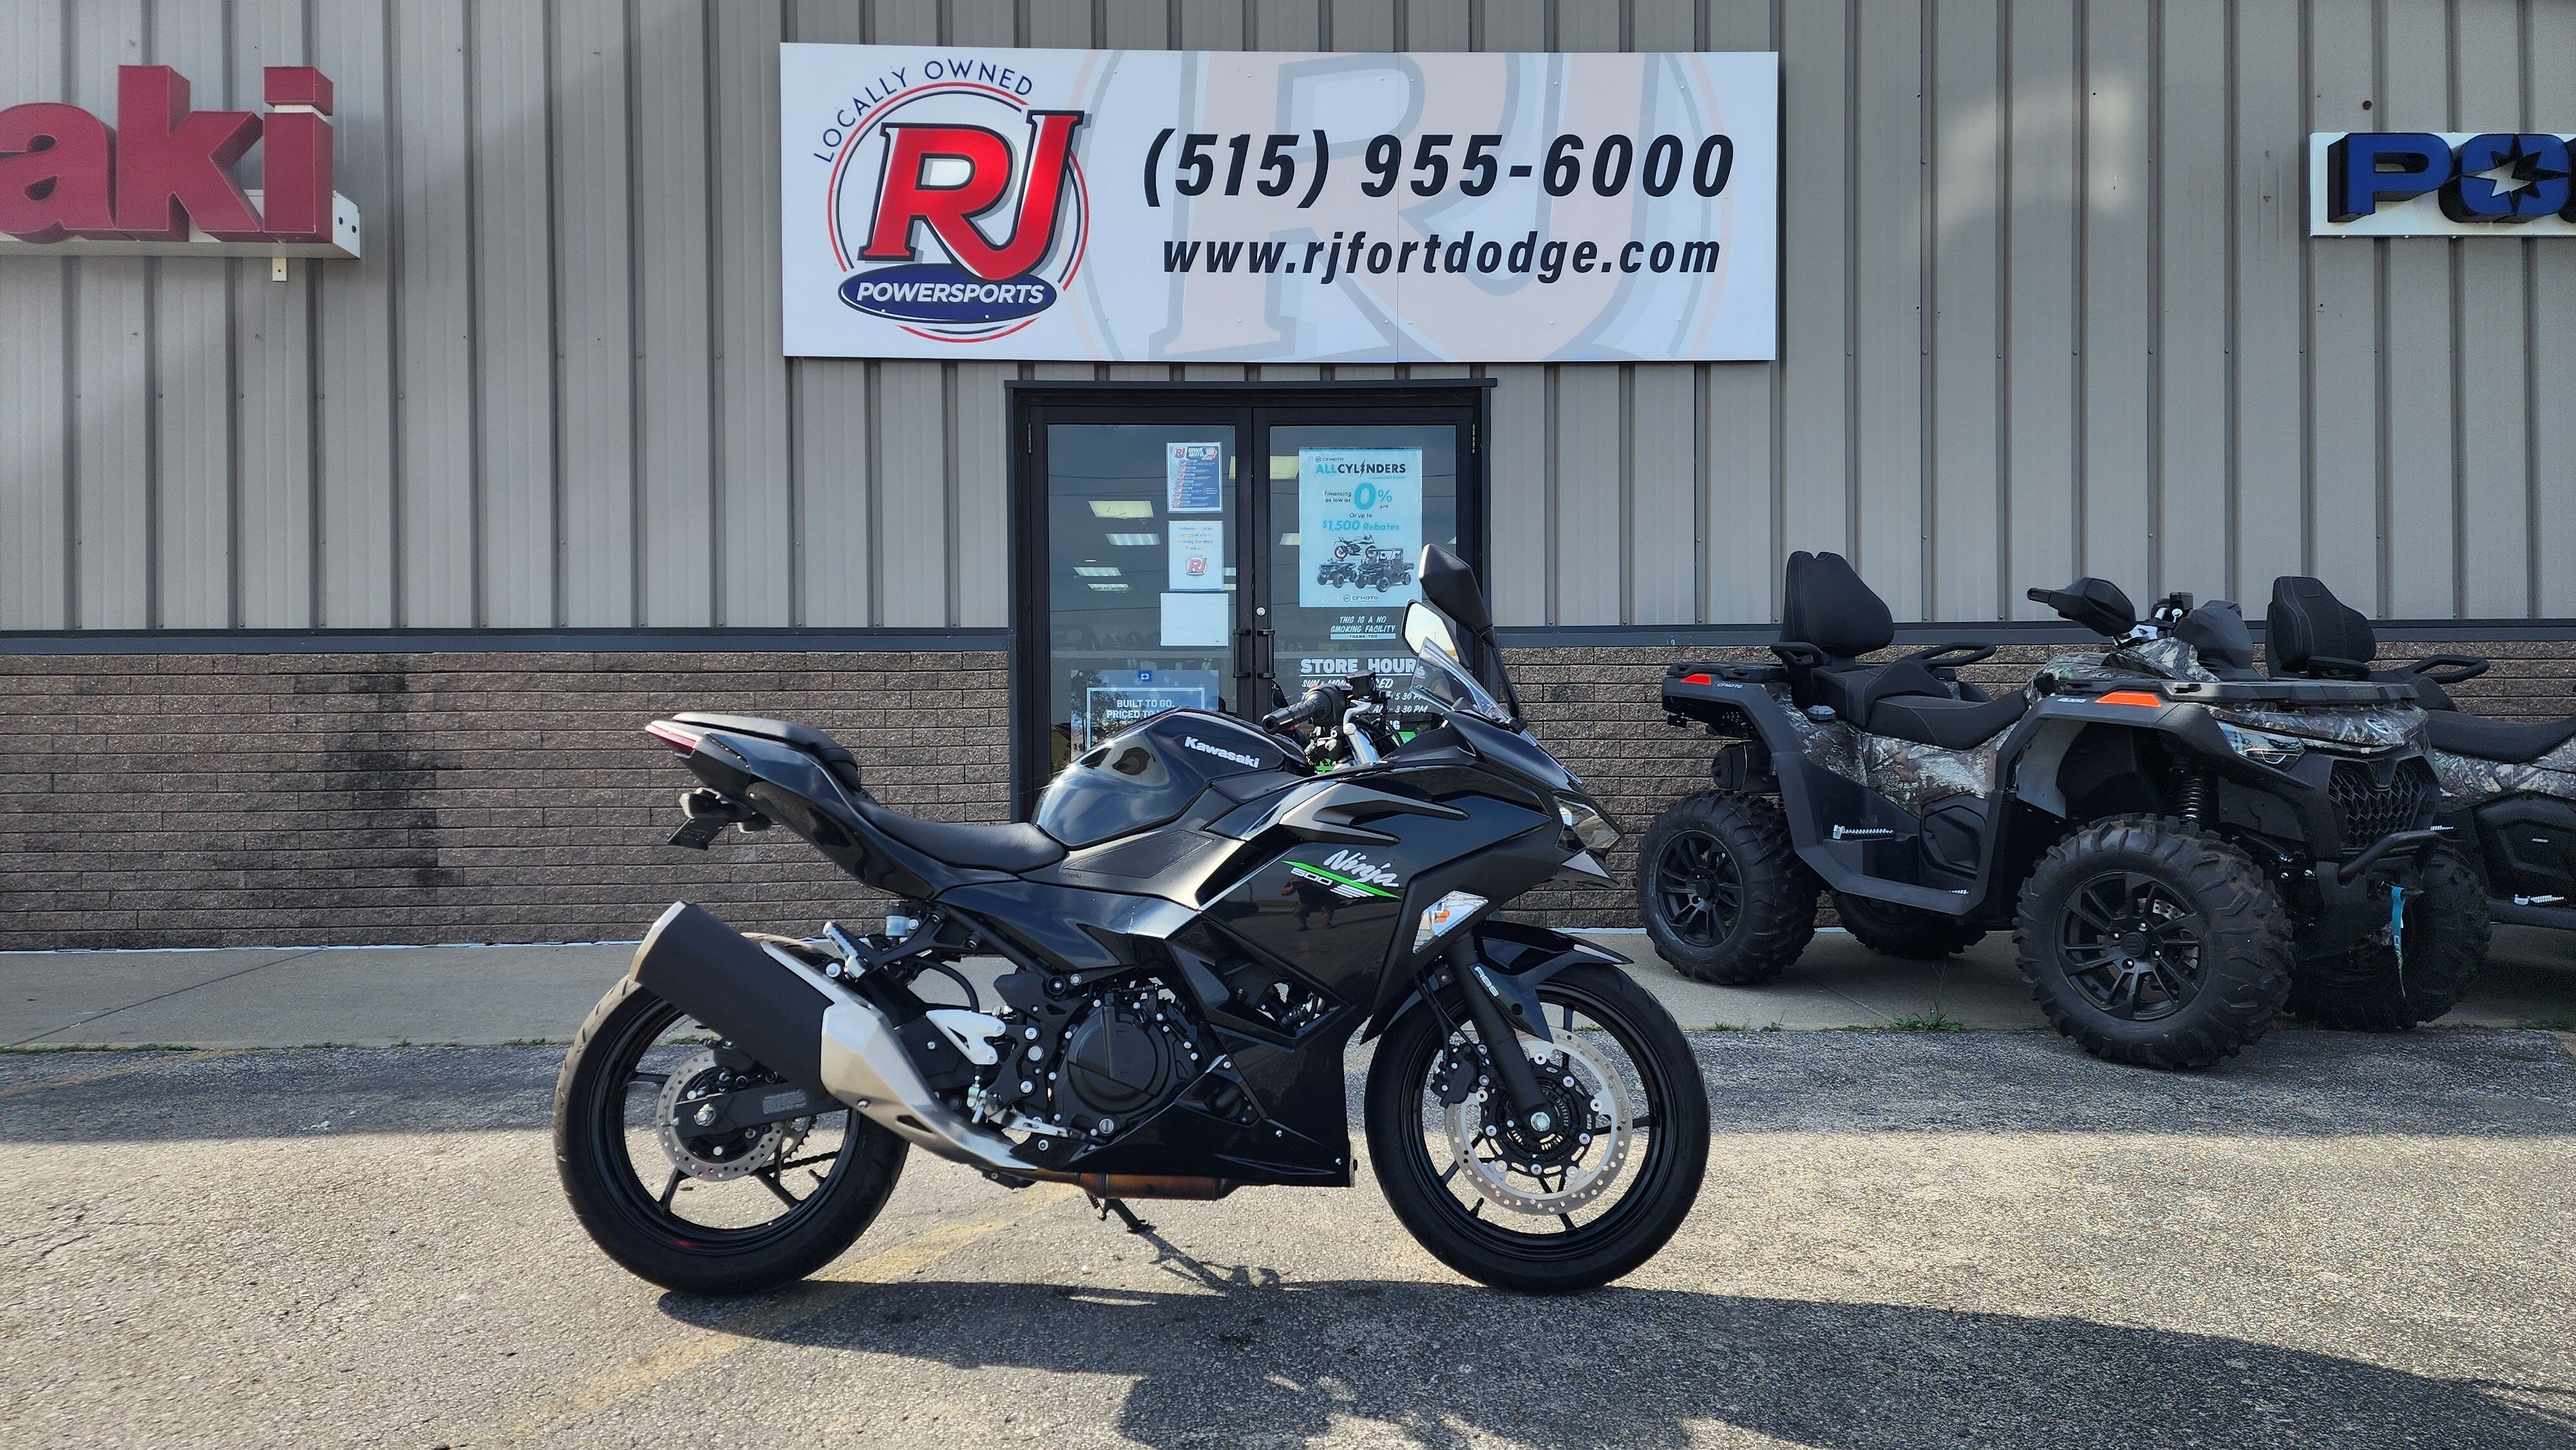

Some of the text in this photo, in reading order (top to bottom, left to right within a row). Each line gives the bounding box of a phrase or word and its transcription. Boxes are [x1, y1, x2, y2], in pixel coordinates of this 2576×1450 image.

[813, 59, 1033, 164] LOCALLY OWNED
[1144, 128, 1734, 208] (515) 955-6000
[2327, 132, 2576, 223] PO
[857, 109, 1086, 281] RJ
[1162, 231, 1720, 284] www.rjfortdodge.com
[856, 281, 1045, 305] POWERSPORTS
[1321, 520, 1399, 532] $1,500 Rebates
[1330, 625, 1396, 633] SMOKING FACILITY
[1340, 616, 1387, 624] THIS IS A NO
[1300, 658, 1358, 673] STORE
[1106, 710, 1141, 719] PRICED
[1117, 699, 1143, 708] BUILT
[1144, 699, 1158, 708] TO
[1413, 704, 1428, 713] PM
[1184, 736, 1260, 769] Kawasaki
[1291, 867, 1333, 886] 500
[1323, 849, 1399, 887] Ninja
[1474, 966, 1499, 997] ABS
